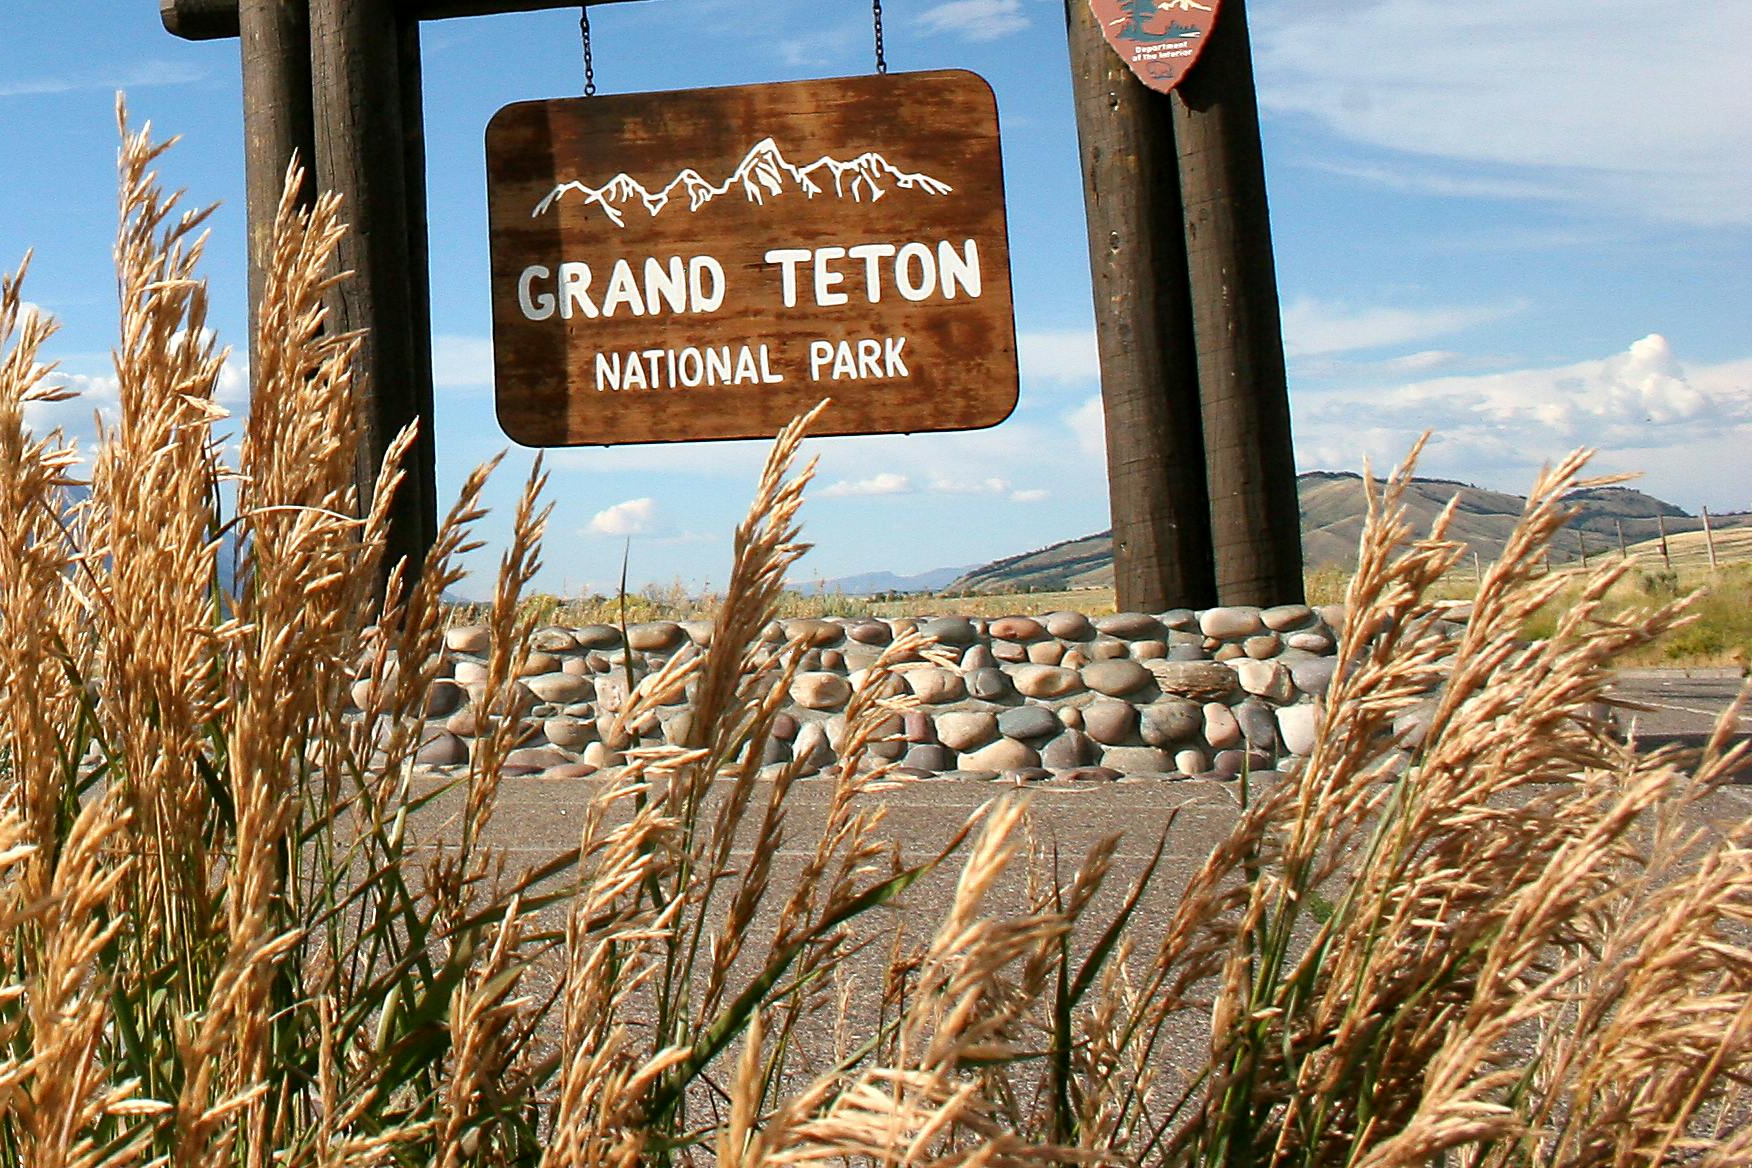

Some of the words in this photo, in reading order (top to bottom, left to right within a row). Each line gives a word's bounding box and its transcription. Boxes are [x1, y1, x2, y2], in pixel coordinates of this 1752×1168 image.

[517, 255, 727, 321] GRAND
[764, 238, 983, 308] TETON
[595, 343, 784, 392] NATIONAL
[810, 336, 909, 382] PARK
